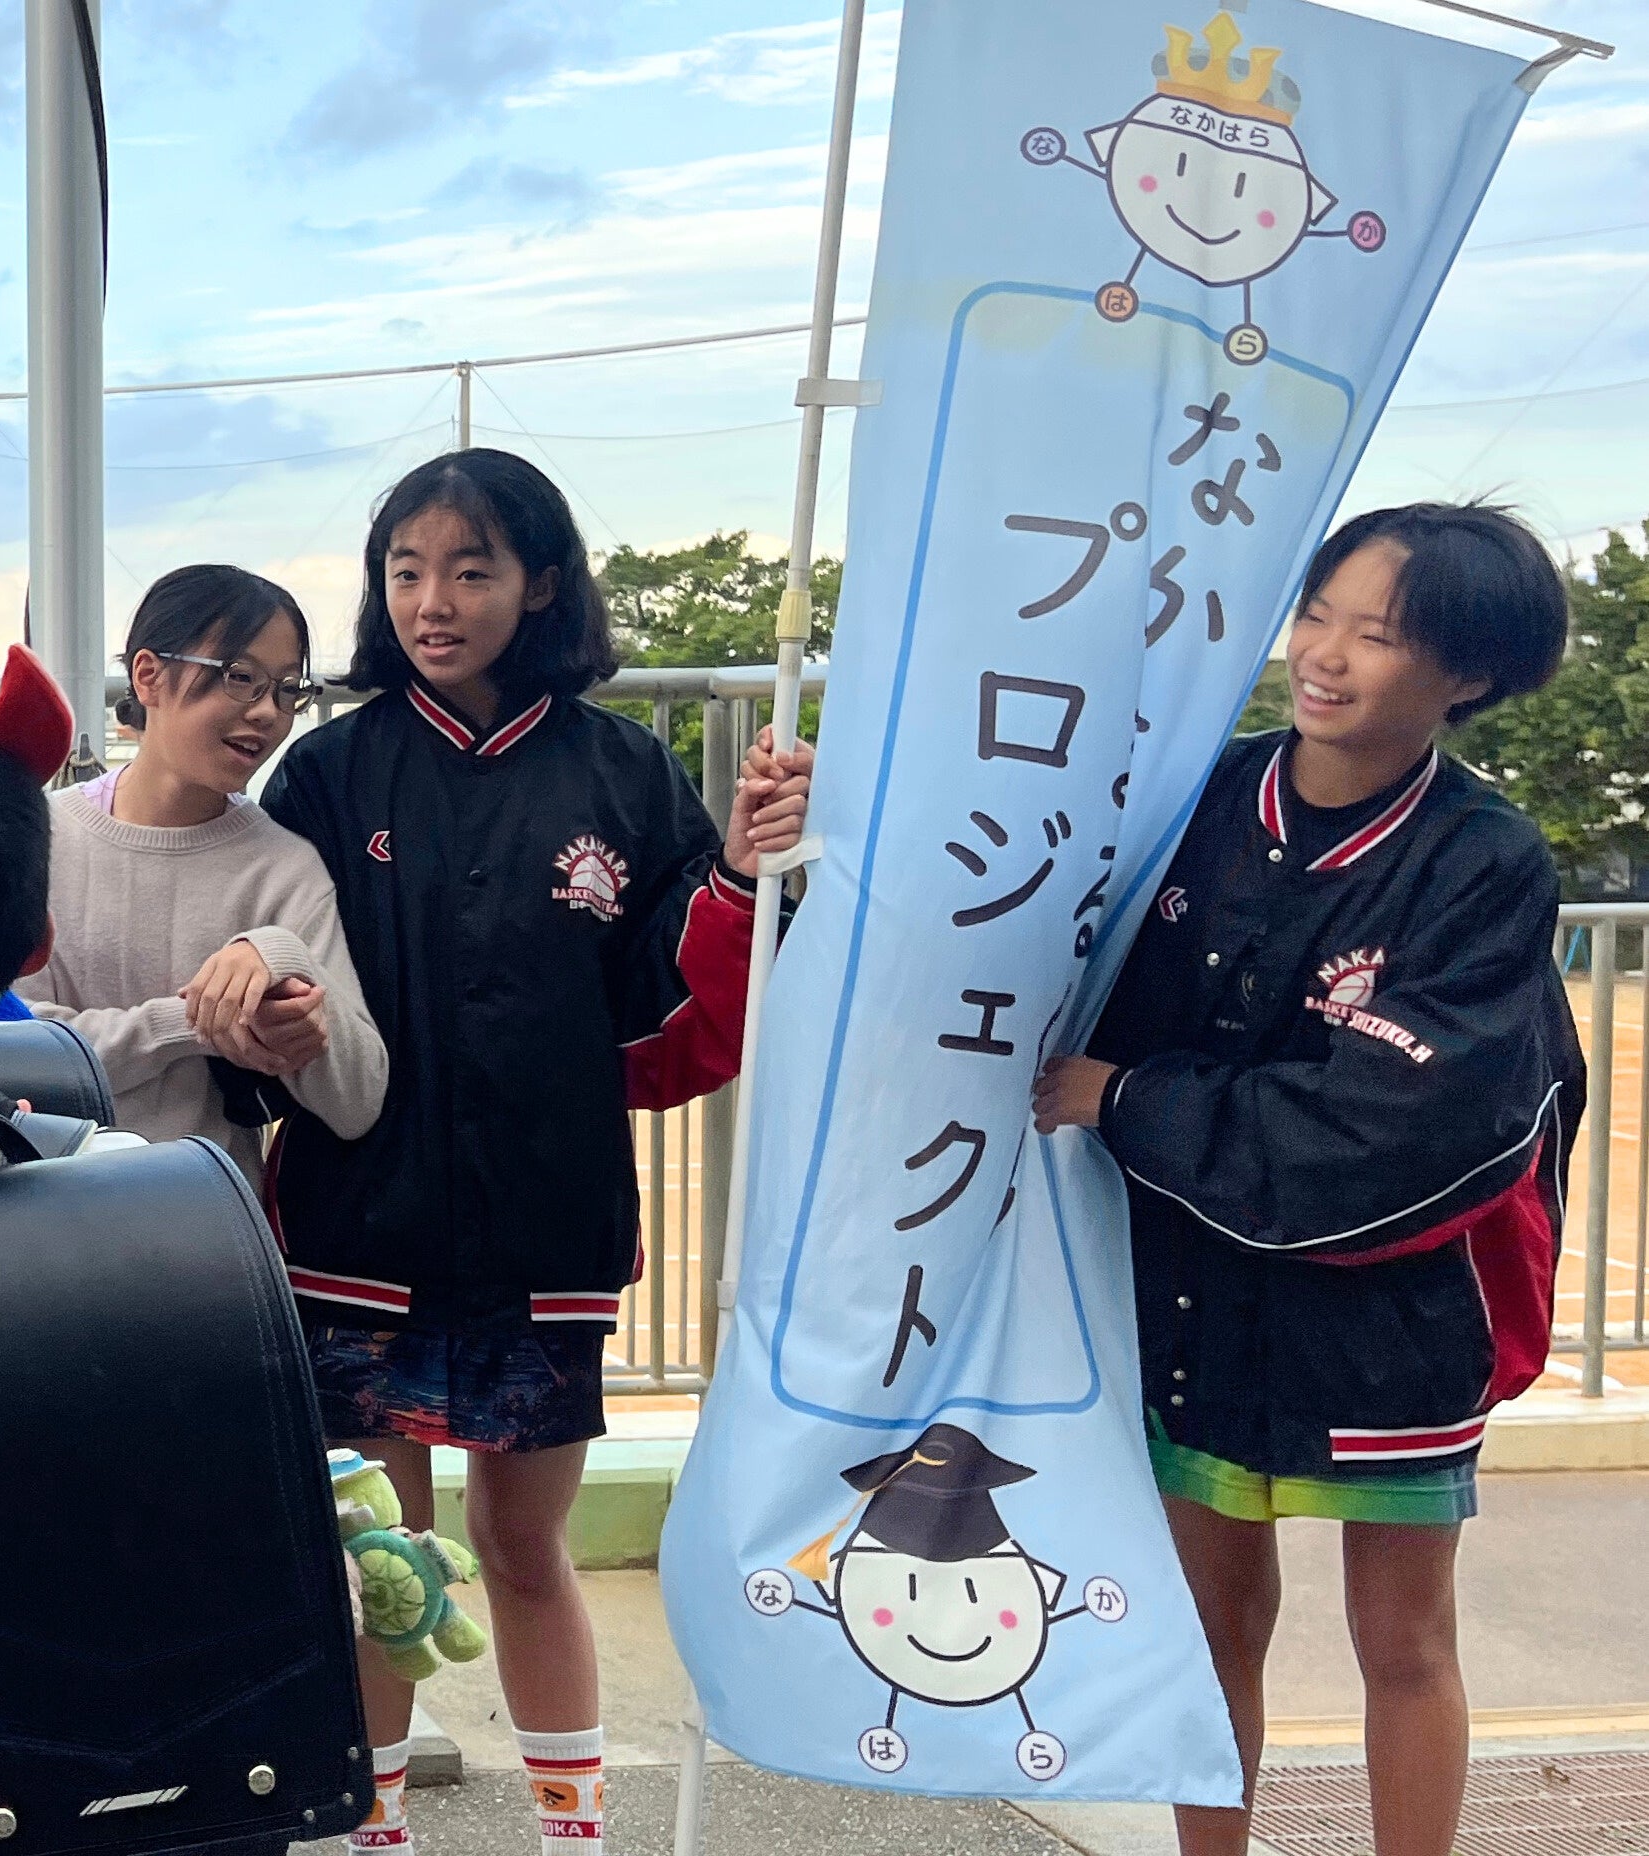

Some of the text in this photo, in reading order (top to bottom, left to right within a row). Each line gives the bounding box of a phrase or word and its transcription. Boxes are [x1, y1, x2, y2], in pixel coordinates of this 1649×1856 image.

[1170, 104, 1271, 149] なかはら
[1031, 134, 1055, 156] な
[1357, 221, 1379, 243] か
[1104, 289, 1128, 312] は
[1236, 332, 1258, 356] ら
[552, 834, 631, 889] NAKAHARA
[883, 501, 1147, 1388] プロジェクト
[753, 1579, 783, 1607] な
[1093, 1585, 1121, 1613] か
[868, 1734, 897, 1762] は
[1029, 1742, 1054, 1771] ら
